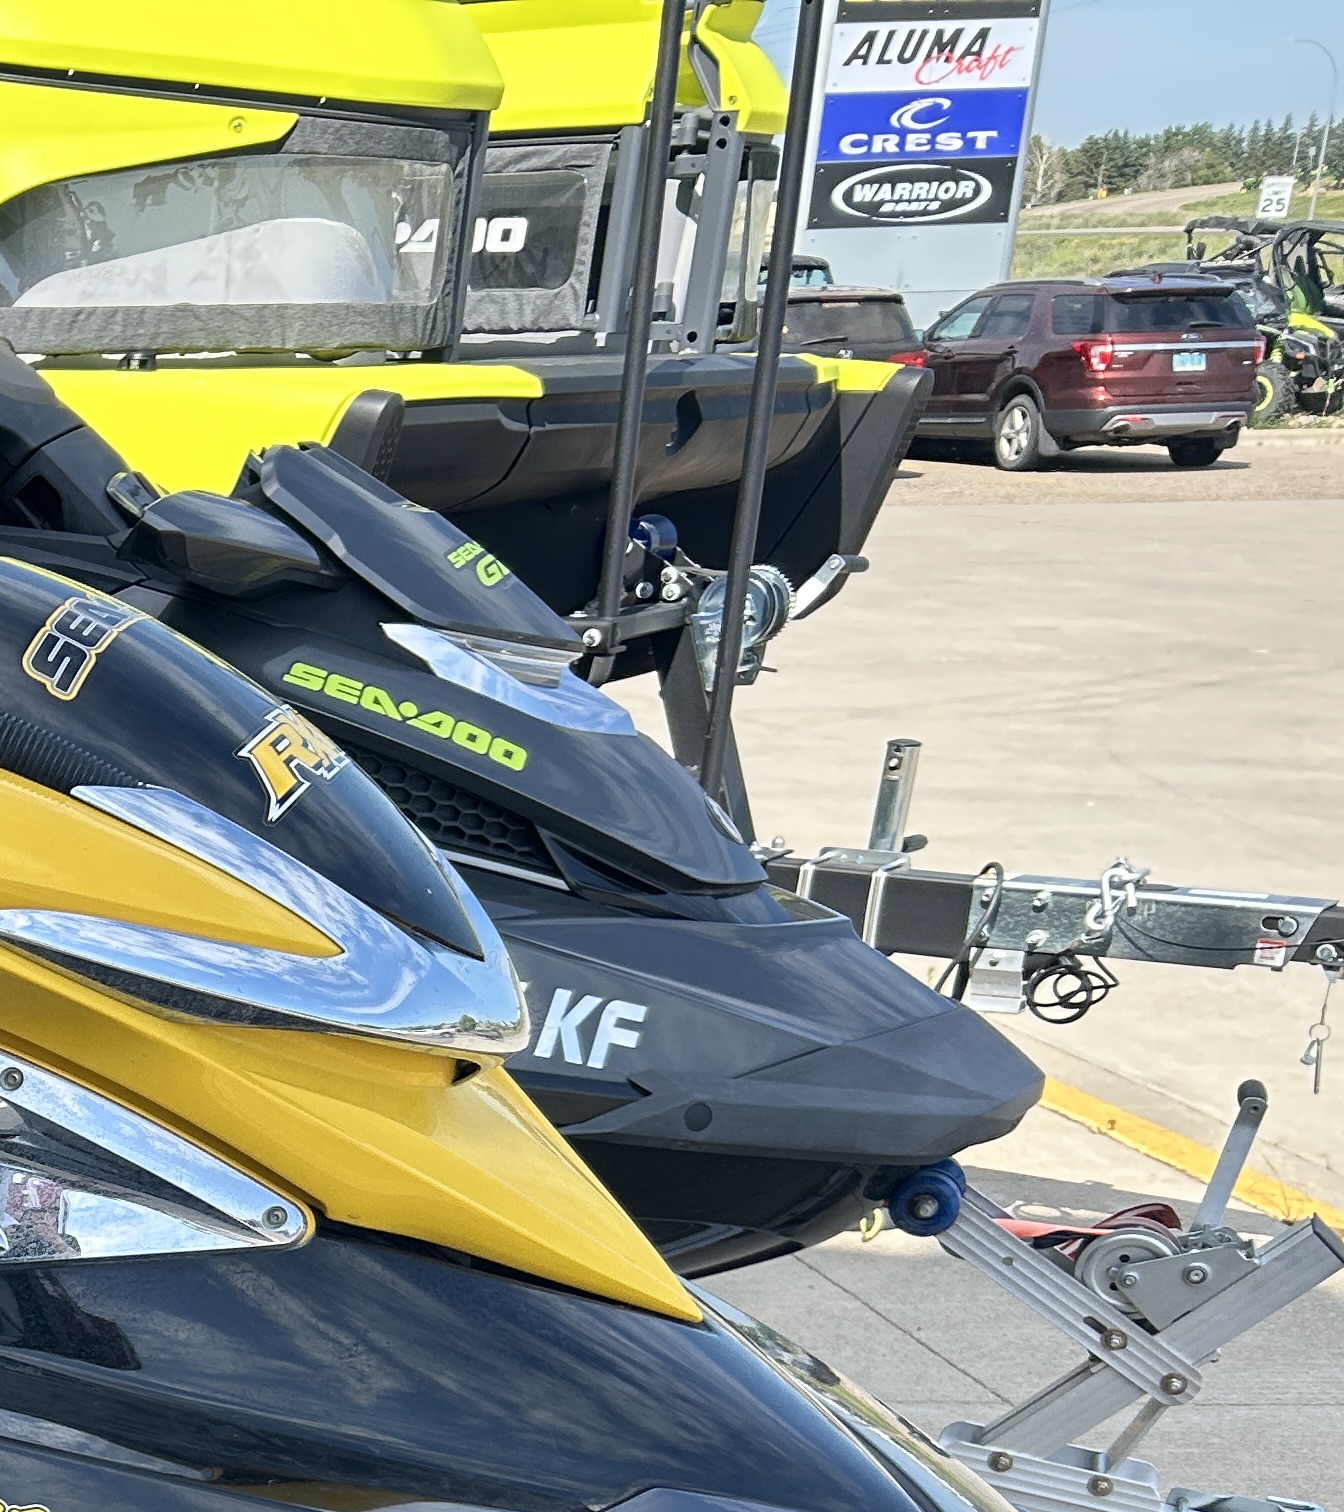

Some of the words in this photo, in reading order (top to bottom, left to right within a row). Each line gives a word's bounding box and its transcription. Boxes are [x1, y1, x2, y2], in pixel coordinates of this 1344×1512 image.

[842, 26, 993, 67] ALUMA
[915, 44, 1024, 85] Craft
[839, 130, 999, 155] CREST
[852, 180, 976, 203] WARRIOR
[878, 201, 942, 213] BOATS
[1261, 197, 1286, 212] 25
[533, 987, 648, 1070] KF
